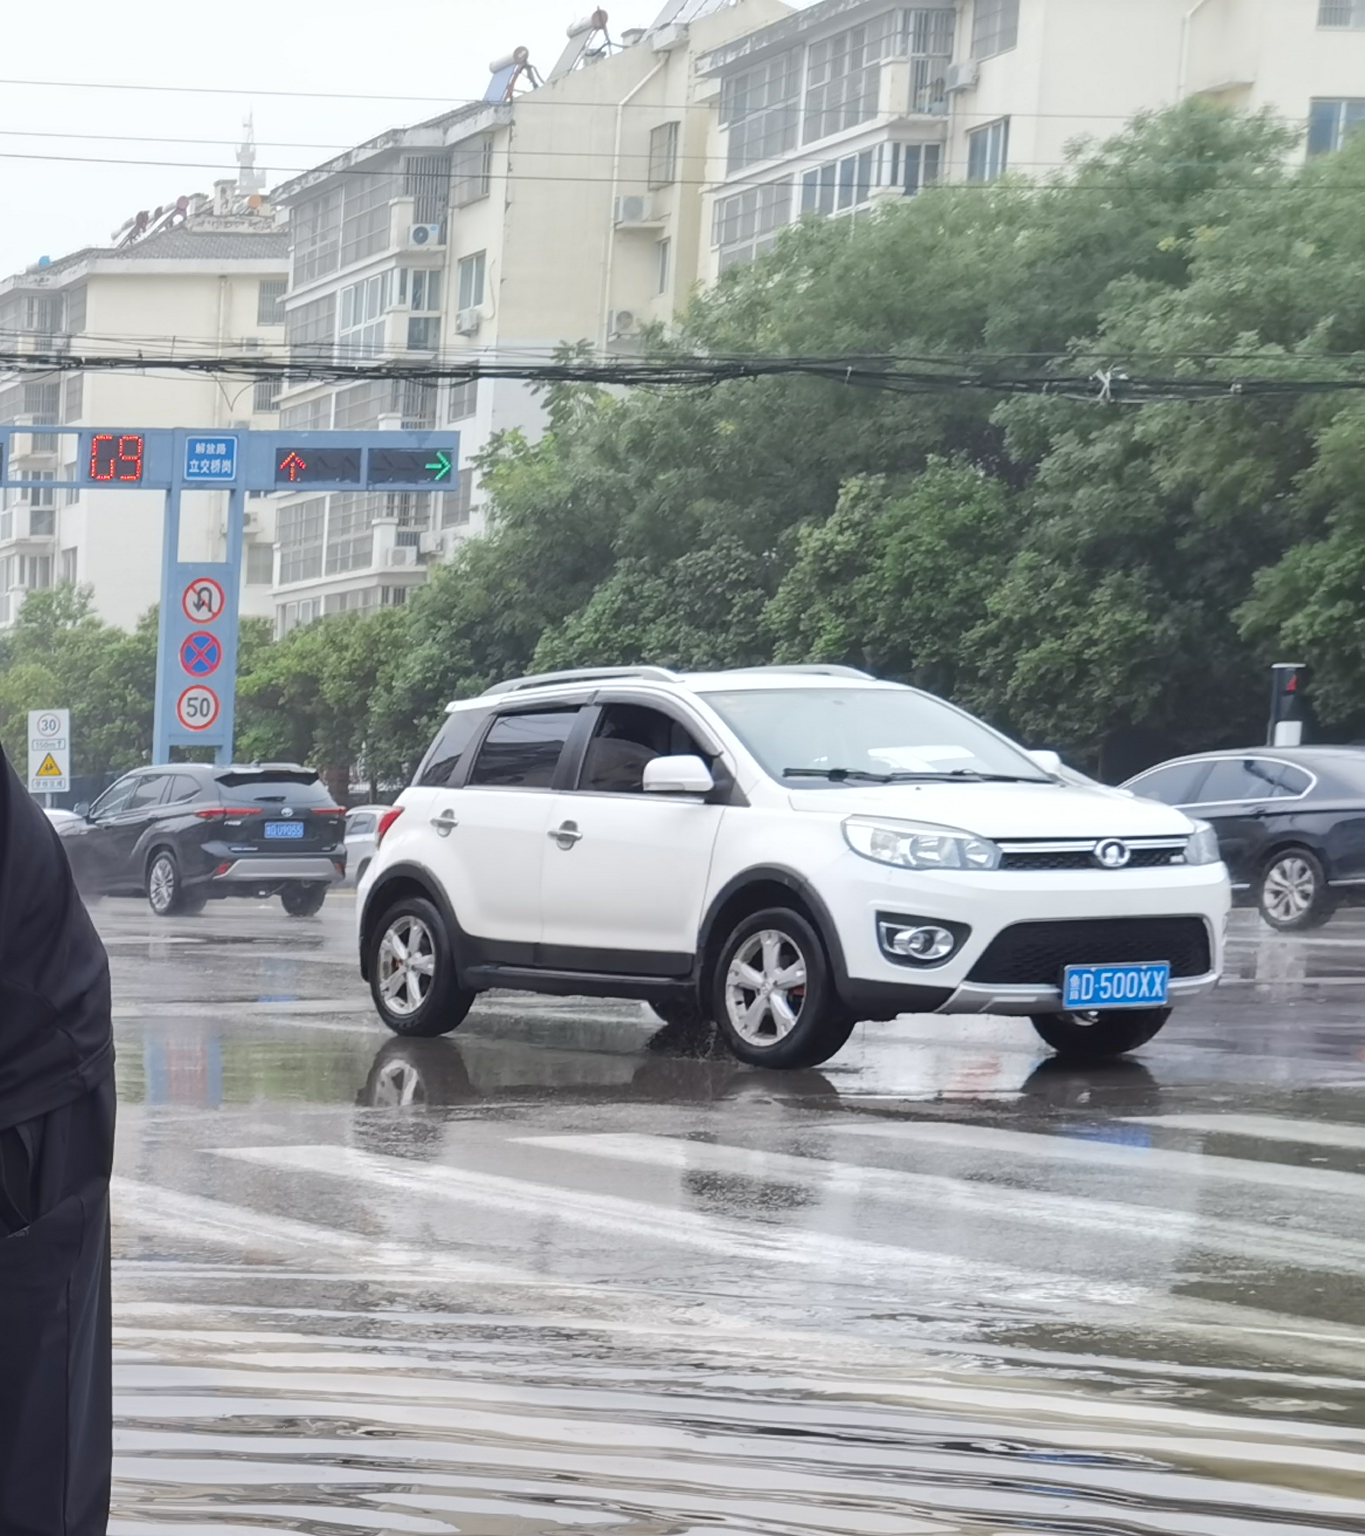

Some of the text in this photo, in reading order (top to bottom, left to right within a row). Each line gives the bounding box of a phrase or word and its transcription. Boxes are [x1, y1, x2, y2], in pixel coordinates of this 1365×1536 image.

[195, 442, 227, 456] 解放路
[188, 458, 232, 475] 立交桥岗
[186, 697, 211, 718] 50
[41, 719, 57, 731] 30
